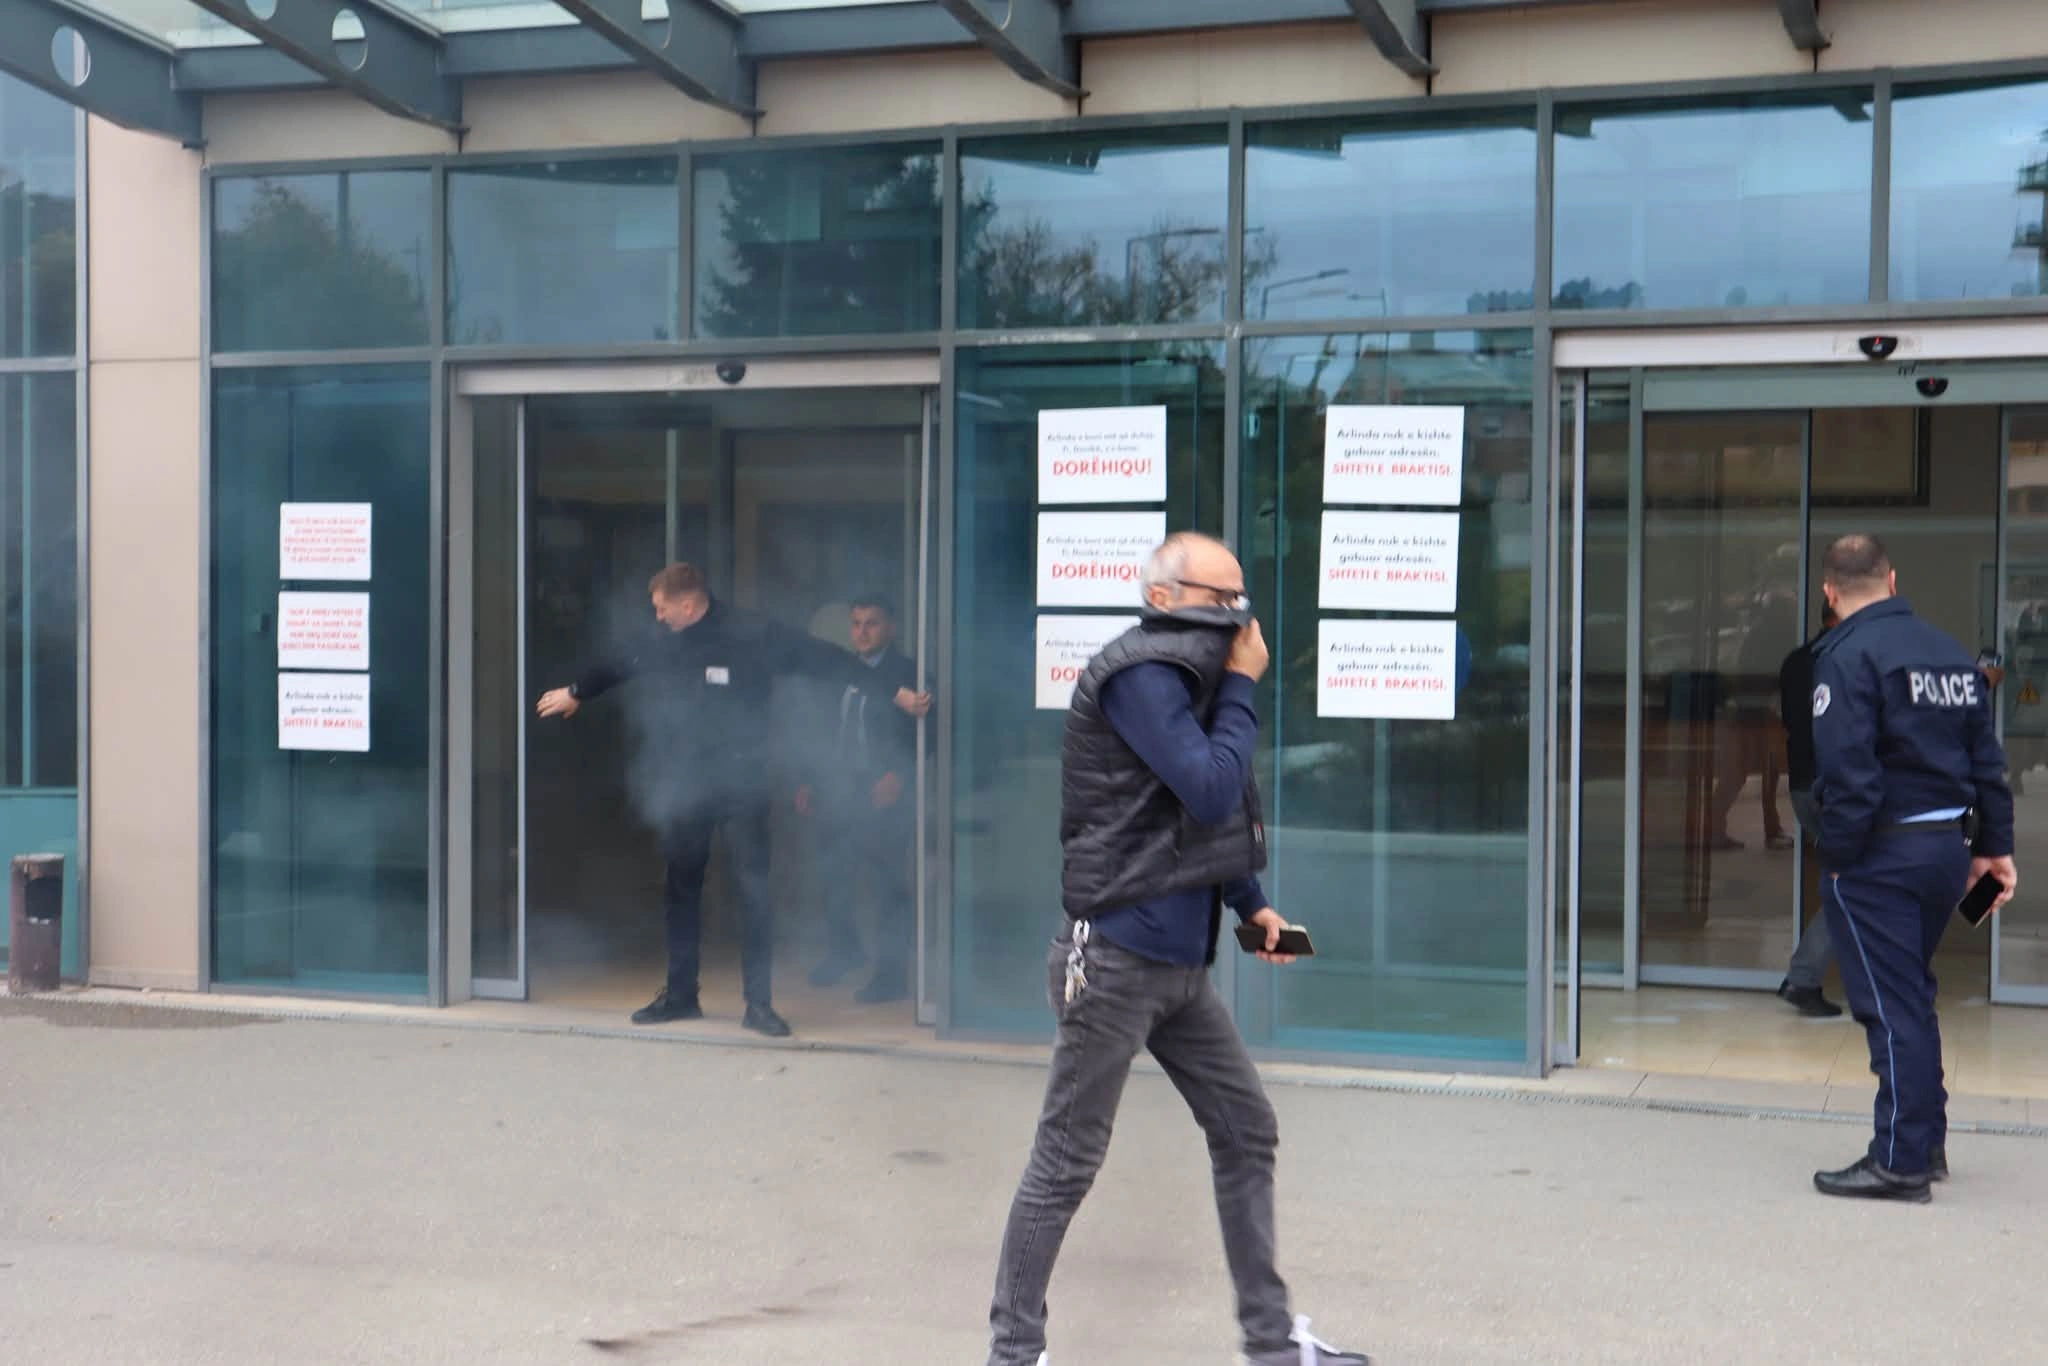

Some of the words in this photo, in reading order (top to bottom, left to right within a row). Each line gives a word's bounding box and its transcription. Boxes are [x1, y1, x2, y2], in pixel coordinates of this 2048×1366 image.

[1336, 428, 1380, 440] Arlinda
[1053, 455, 1152, 477] DORËHIQU!
[1332, 533, 1375, 545] Arlinda
[1052, 560, 1144, 583] DORËHIQU
[1330, 642, 1373, 653] Arlinda
